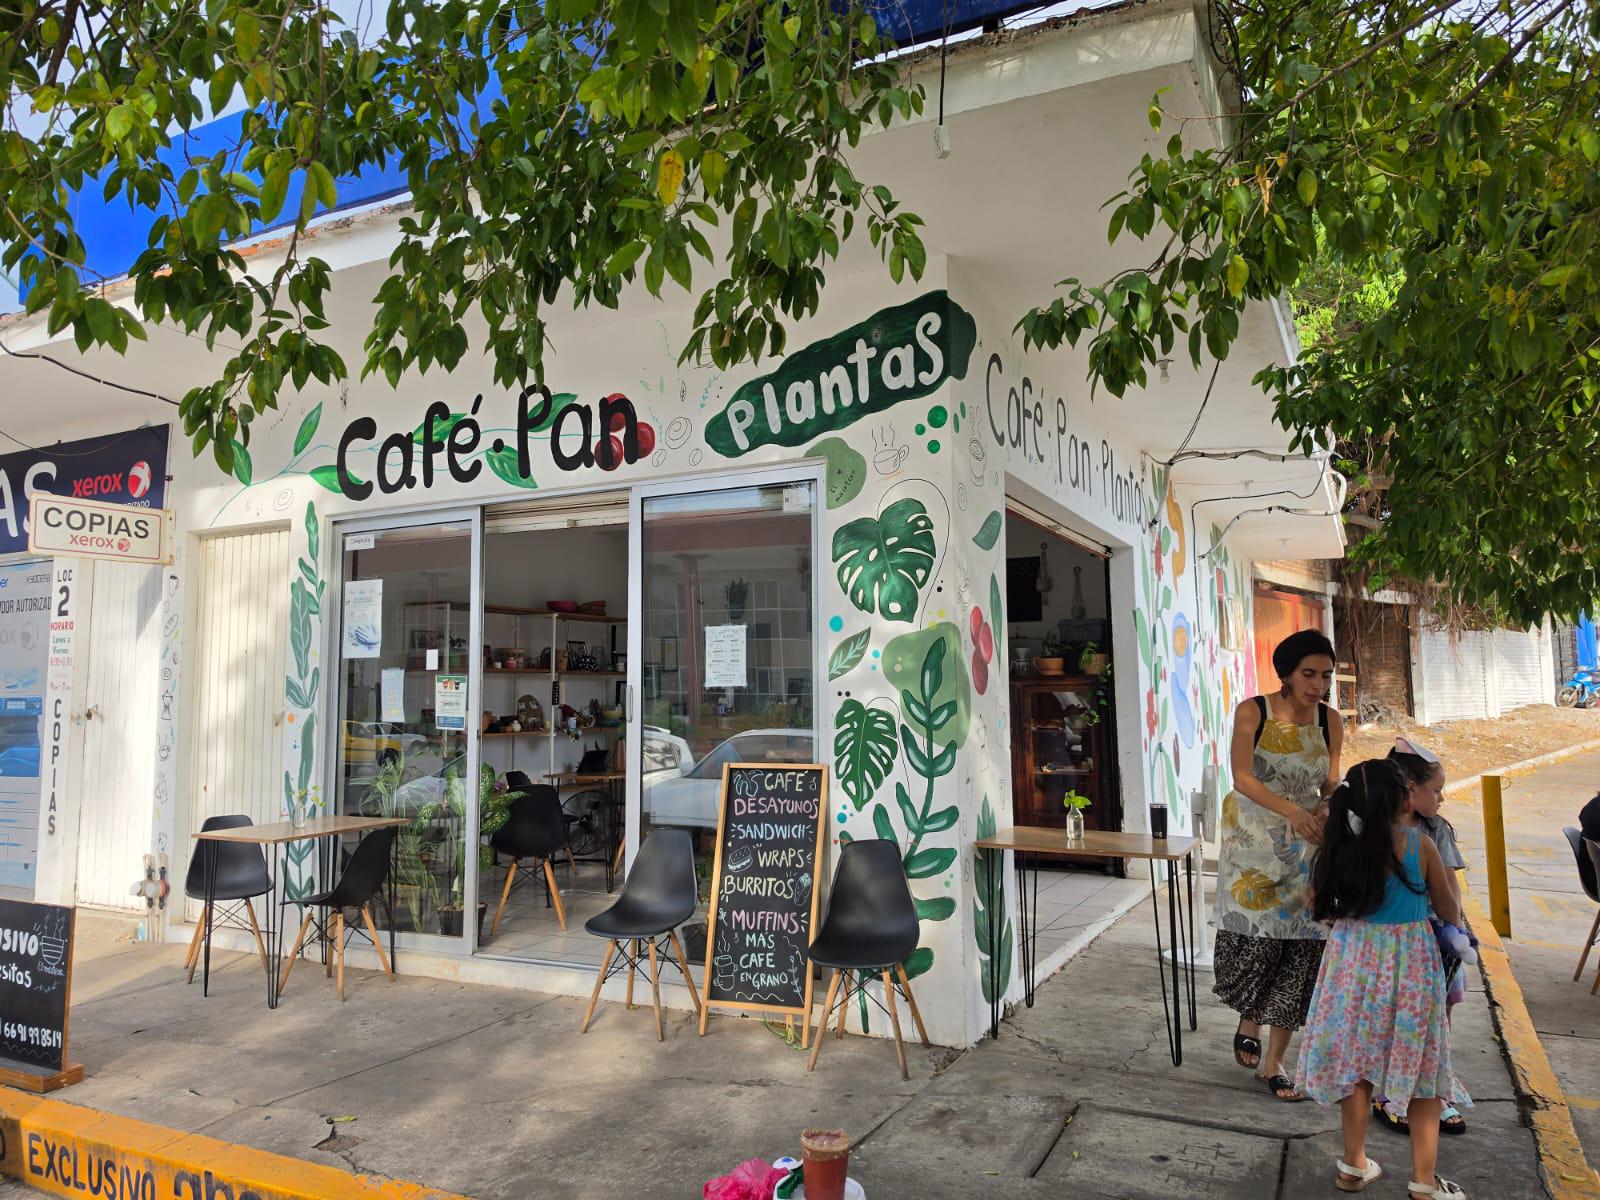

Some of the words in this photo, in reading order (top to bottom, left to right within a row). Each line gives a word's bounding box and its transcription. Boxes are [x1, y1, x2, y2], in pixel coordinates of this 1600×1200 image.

[1056, 397, 1092, 497] Pan
[72, 471, 123, 498] xerox
[44, 506, 150, 539] COPIAS
[69, 534, 114, 549] xerox
[57, 569, 73, 582] LOC
[57, 585, 70, 617] 2
[50, 621, 74, 631] HORARIO
[48, 699, 62, 836] COPIAS
[734, 797, 819, 819] DESAYUNOS
[738, 823, 806, 840] SANDWICH
[757, 848, 805, 868] WRAPS
[724, 875, 795, 899] BURRITOS
[732, 909, 799, 934] MUFFINS
[740, 972, 752, 982] EN
[752, 972, 788, 990] GRANO
